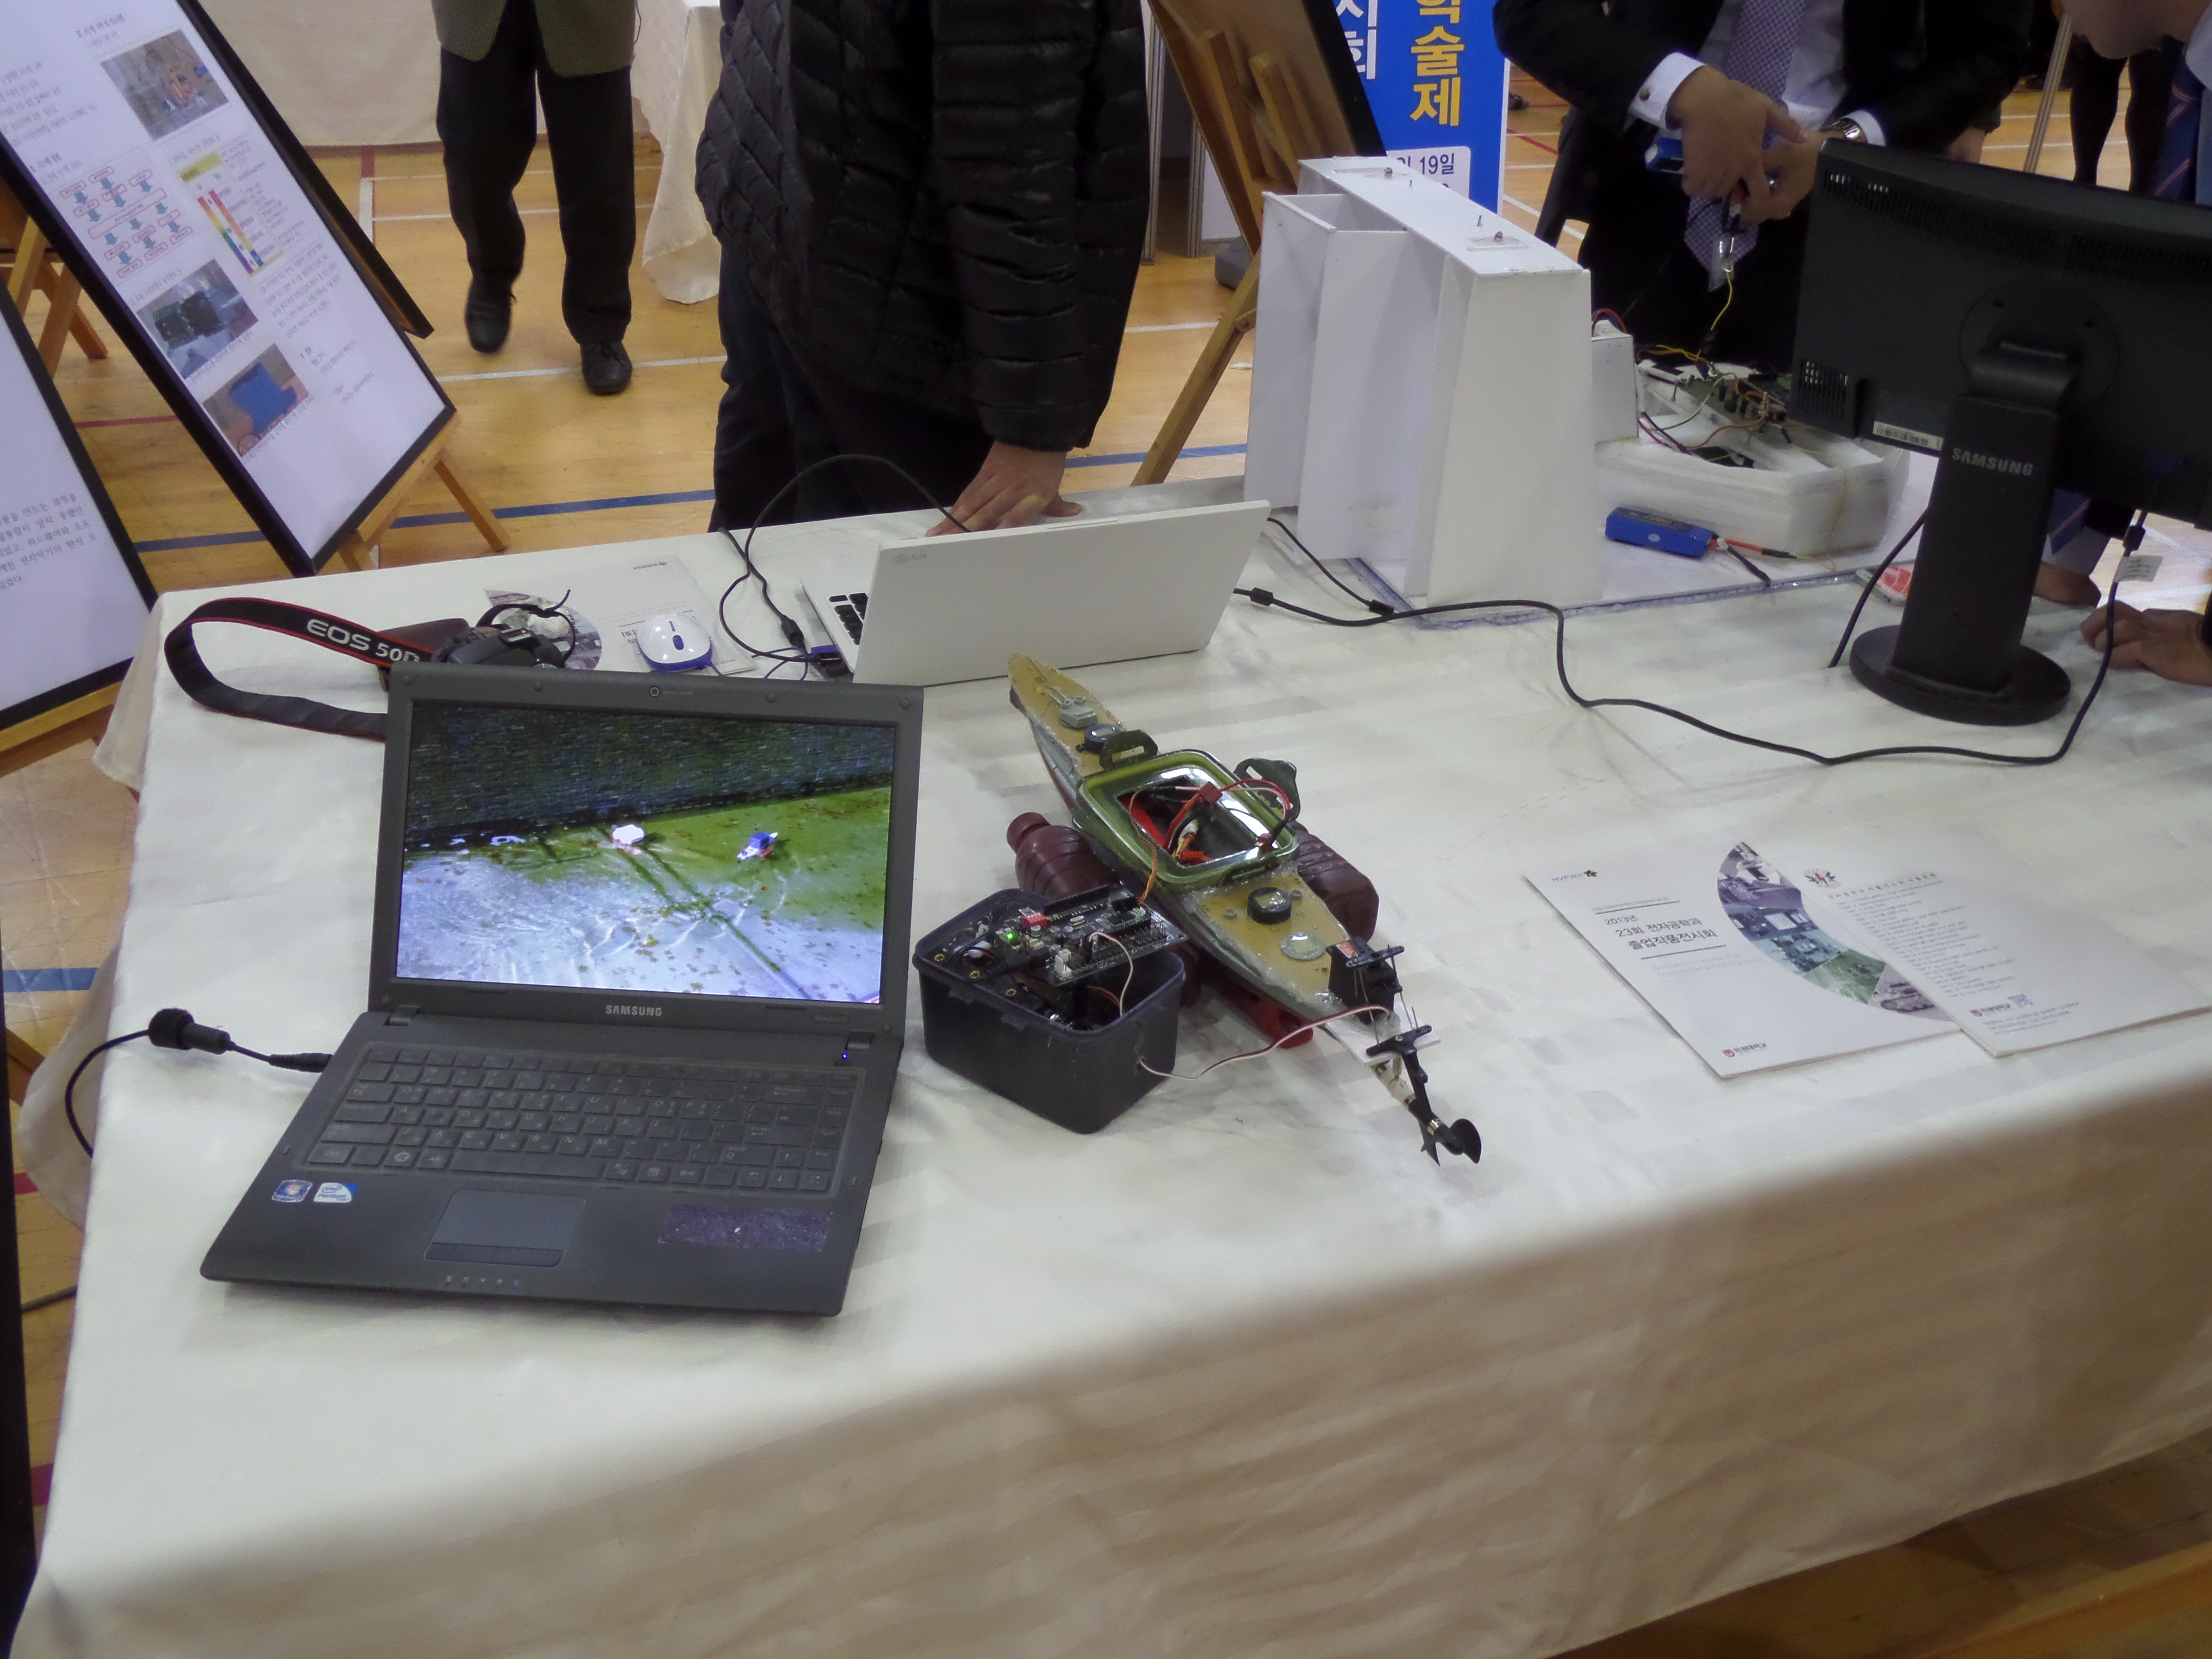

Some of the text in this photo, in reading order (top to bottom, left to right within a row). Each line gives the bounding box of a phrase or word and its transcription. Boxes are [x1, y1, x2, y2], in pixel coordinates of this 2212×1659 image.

[1420, 153, 1455, 175] 19일
[1952, 447, 2033, 476] SAMSUNG
[307, 619, 371, 651] EOS
[1604, 914, 1638, 926] 2013년
[1615, 917, 1703, 938] 23회 전자공학과
[1628, 929, 1718, 950] 졸업작품전시회
[605, 1005, 662, 1016] SAMSUNG
